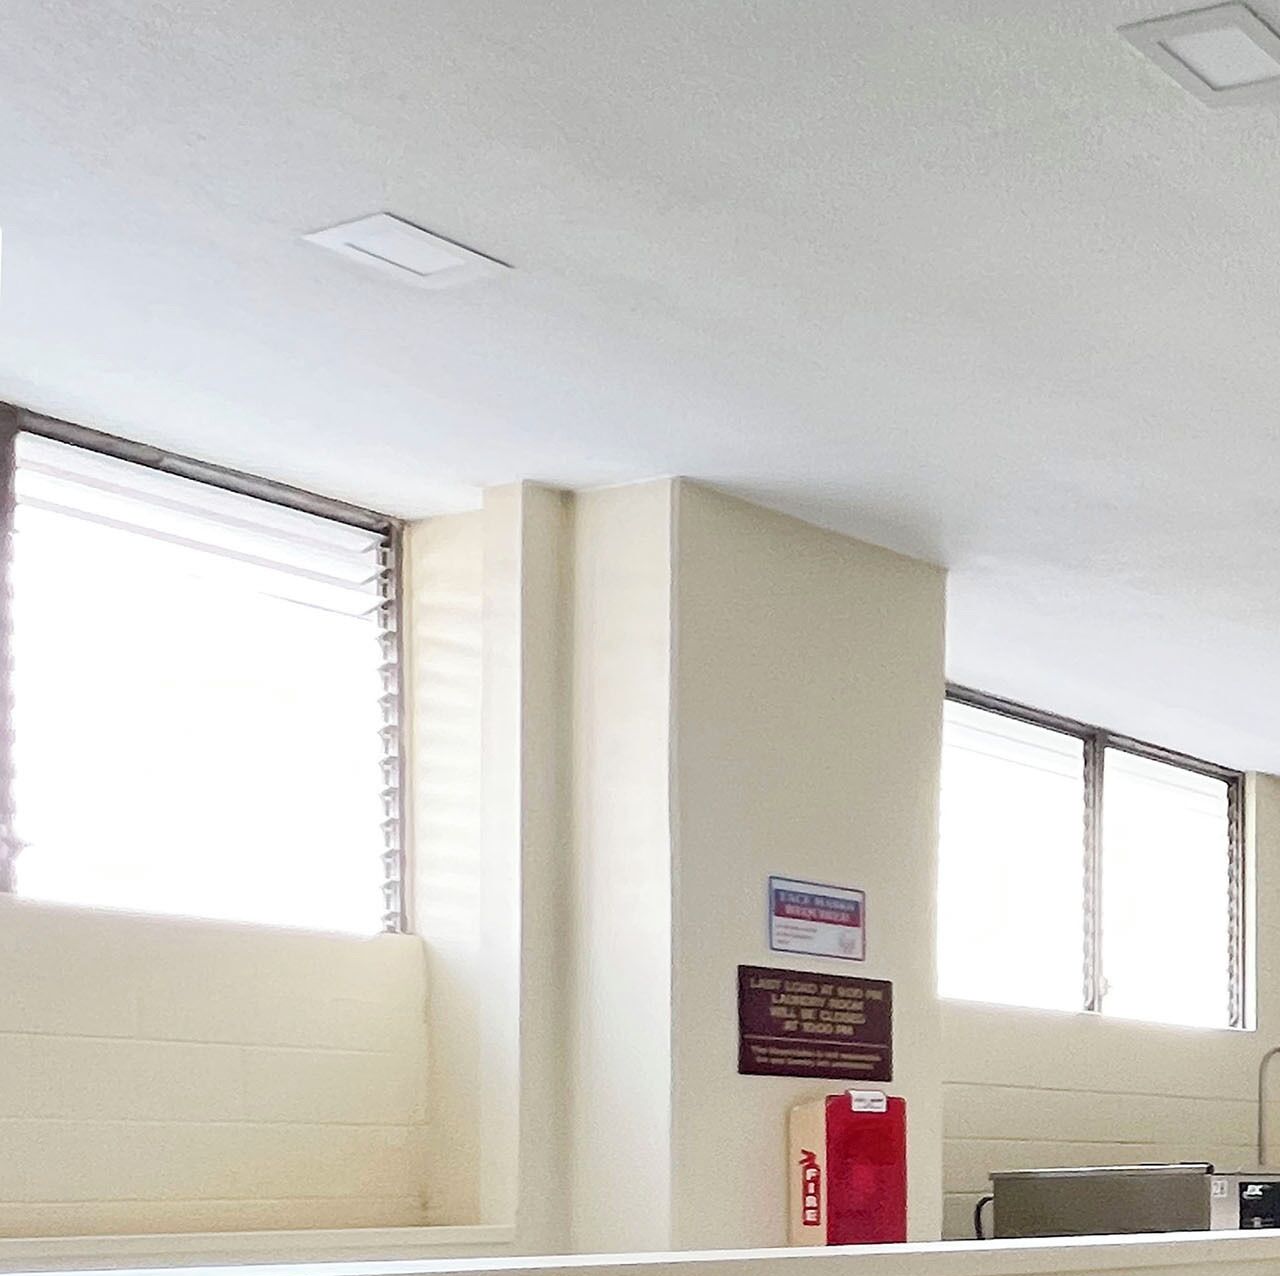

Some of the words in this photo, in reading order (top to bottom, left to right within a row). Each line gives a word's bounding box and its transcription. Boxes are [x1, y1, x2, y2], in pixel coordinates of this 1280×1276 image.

[784, 979, 818, 994] LOAD
[771, 993, 826, 1008] LAUNDRY
[769, 1006, 797, 1018] WILL
[820, 1009, 867, 1024] CLOSED
[784, 1020, 798, 1031] AT
[835, 1024, 855, 1035] PM
[805, 1167, 819, 1222] FIRE
